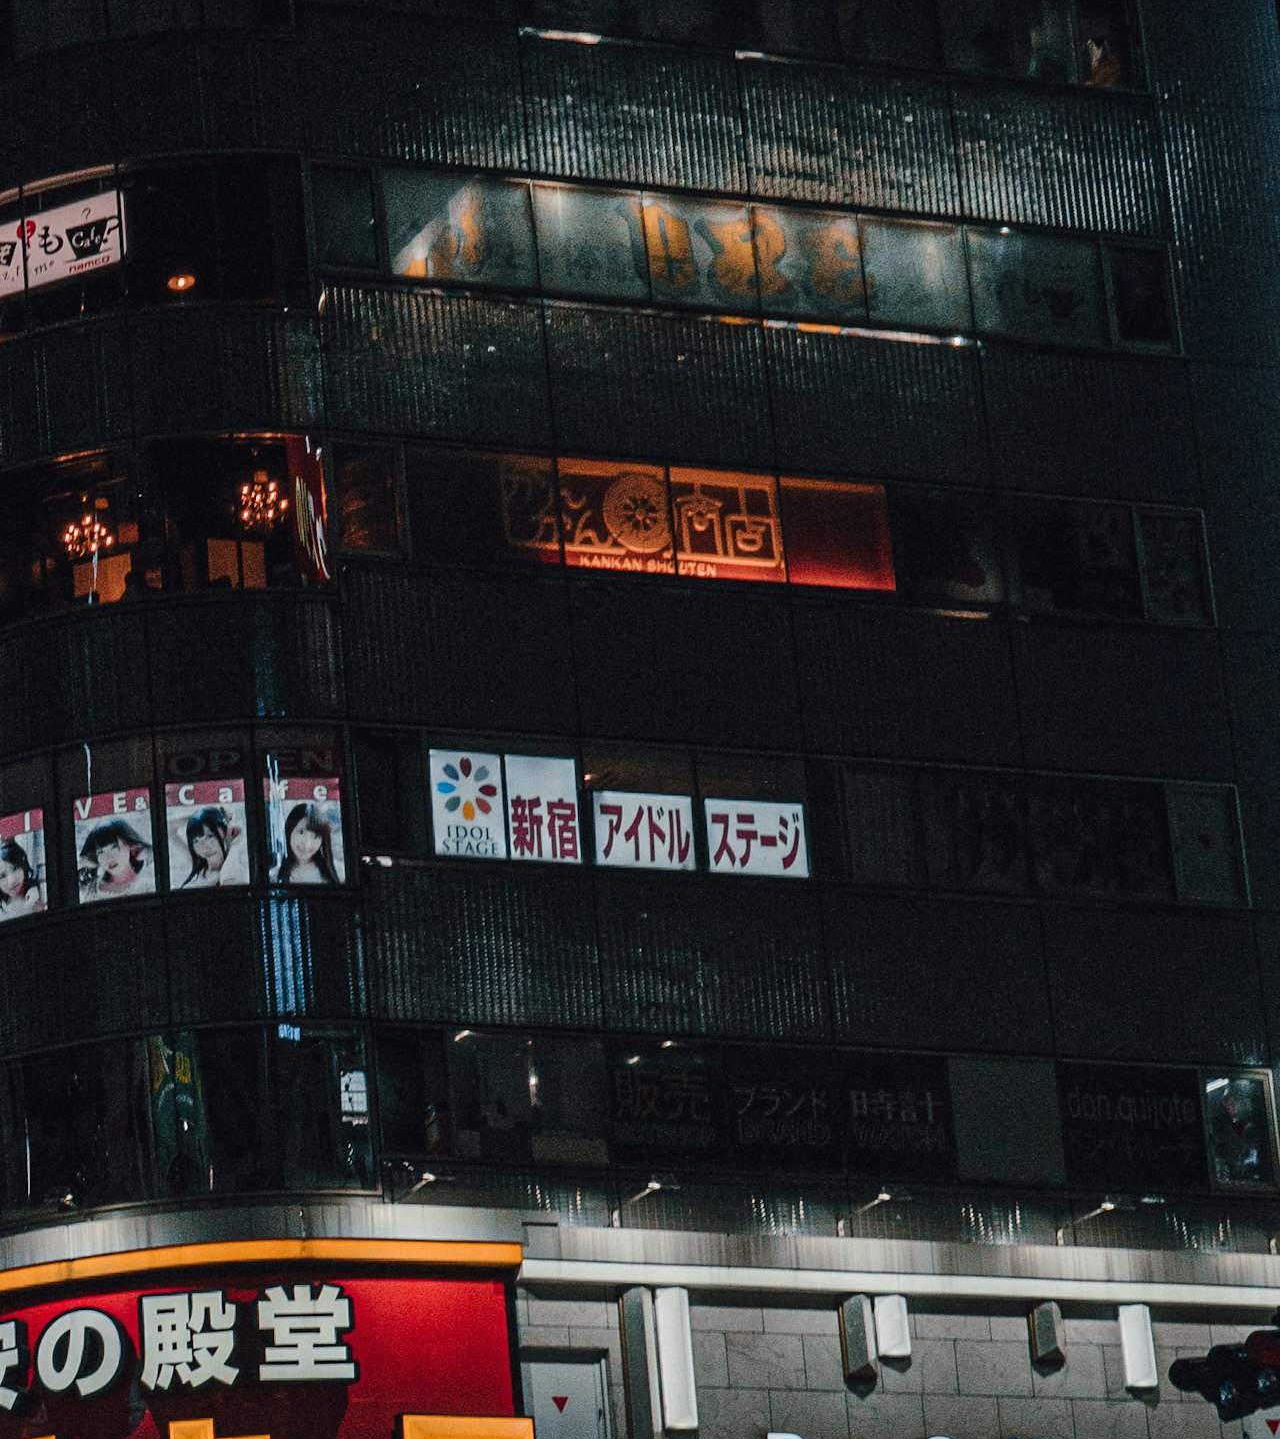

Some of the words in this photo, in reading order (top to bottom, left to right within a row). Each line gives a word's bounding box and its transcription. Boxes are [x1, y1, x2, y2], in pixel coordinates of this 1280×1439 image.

[68, 255, 111, 274] namco
[447, 824, 493, 840] IDOL
[511, 795, 580, 860] 新宿
[599, 803, 691, 865] アイドル
[710, 811, 804, 870] ステージ
[442, 839, 500, 855] STAGE
